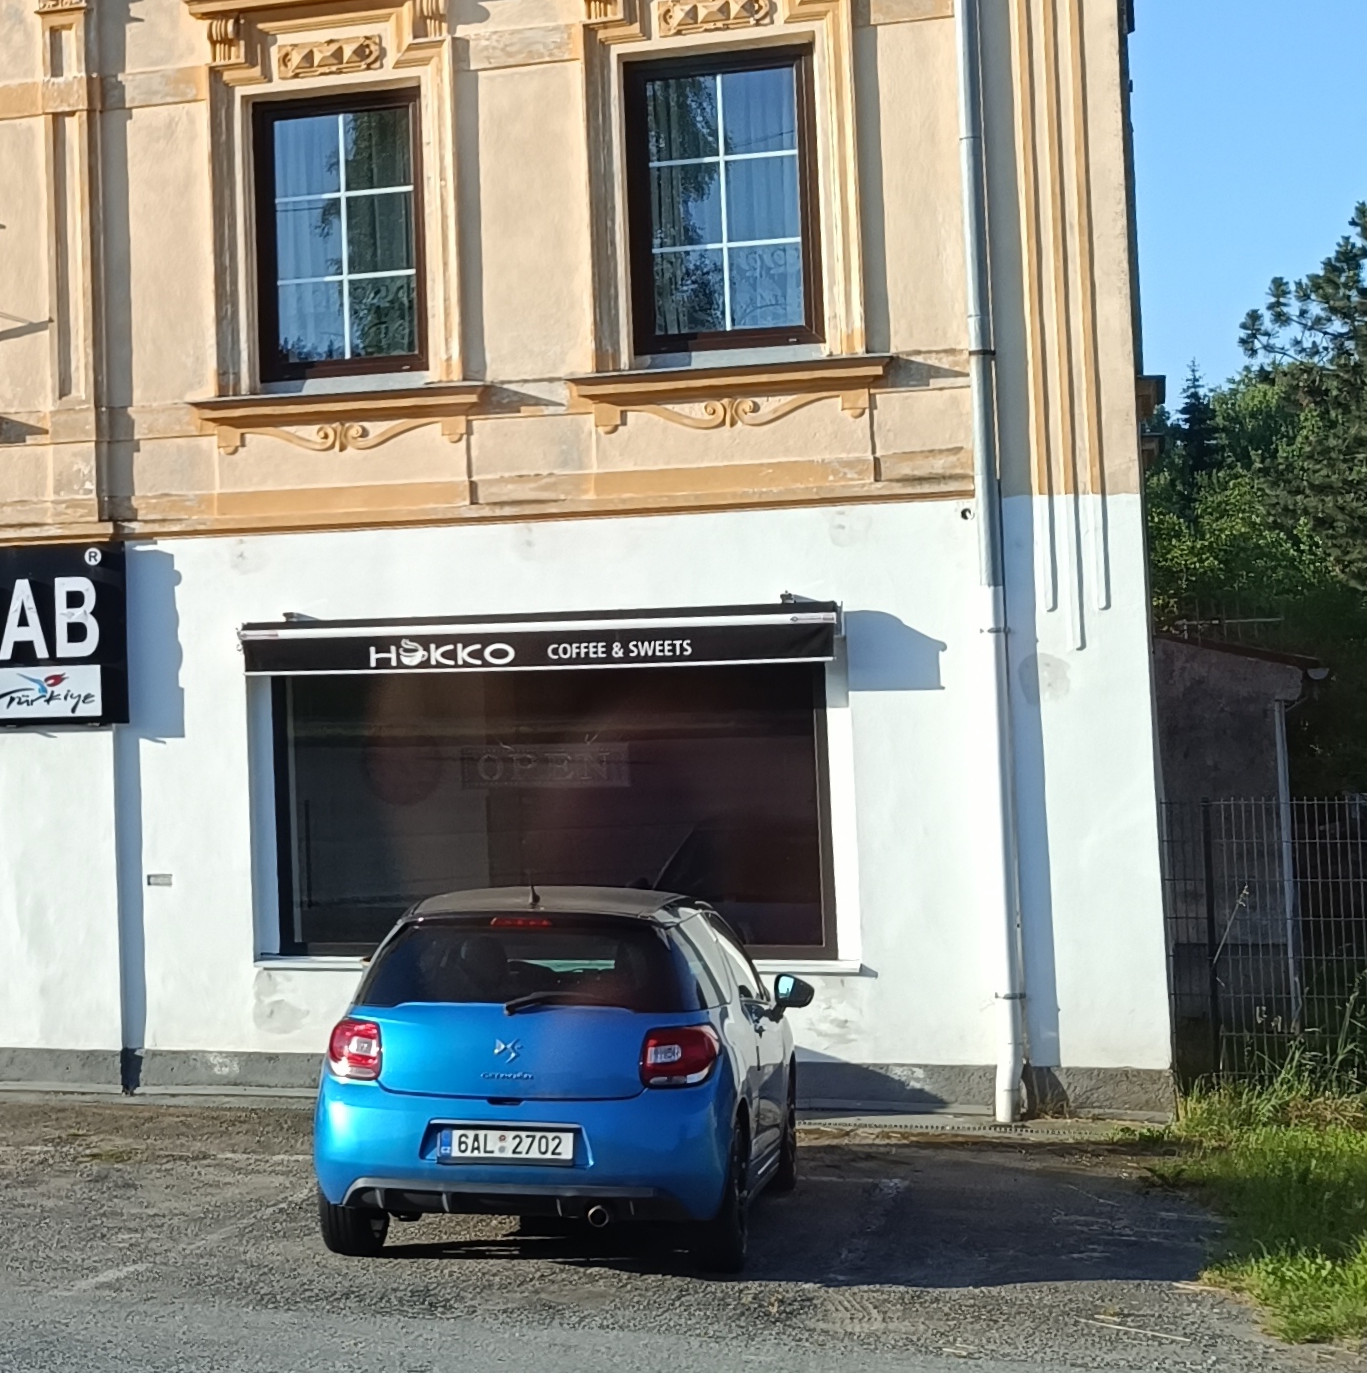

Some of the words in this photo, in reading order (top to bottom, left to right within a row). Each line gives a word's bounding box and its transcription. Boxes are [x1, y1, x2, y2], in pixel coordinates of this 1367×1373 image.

[369, 638, 515, 667] HOKKO
[547, 642, 607, 660] COFFEE
[611, 642, 625, 657] &
[628, 639, 693, 657] SWEETS
[457, 1133, 495, 1154] 6AL
[511, 1134, 563, 1156] 2702
